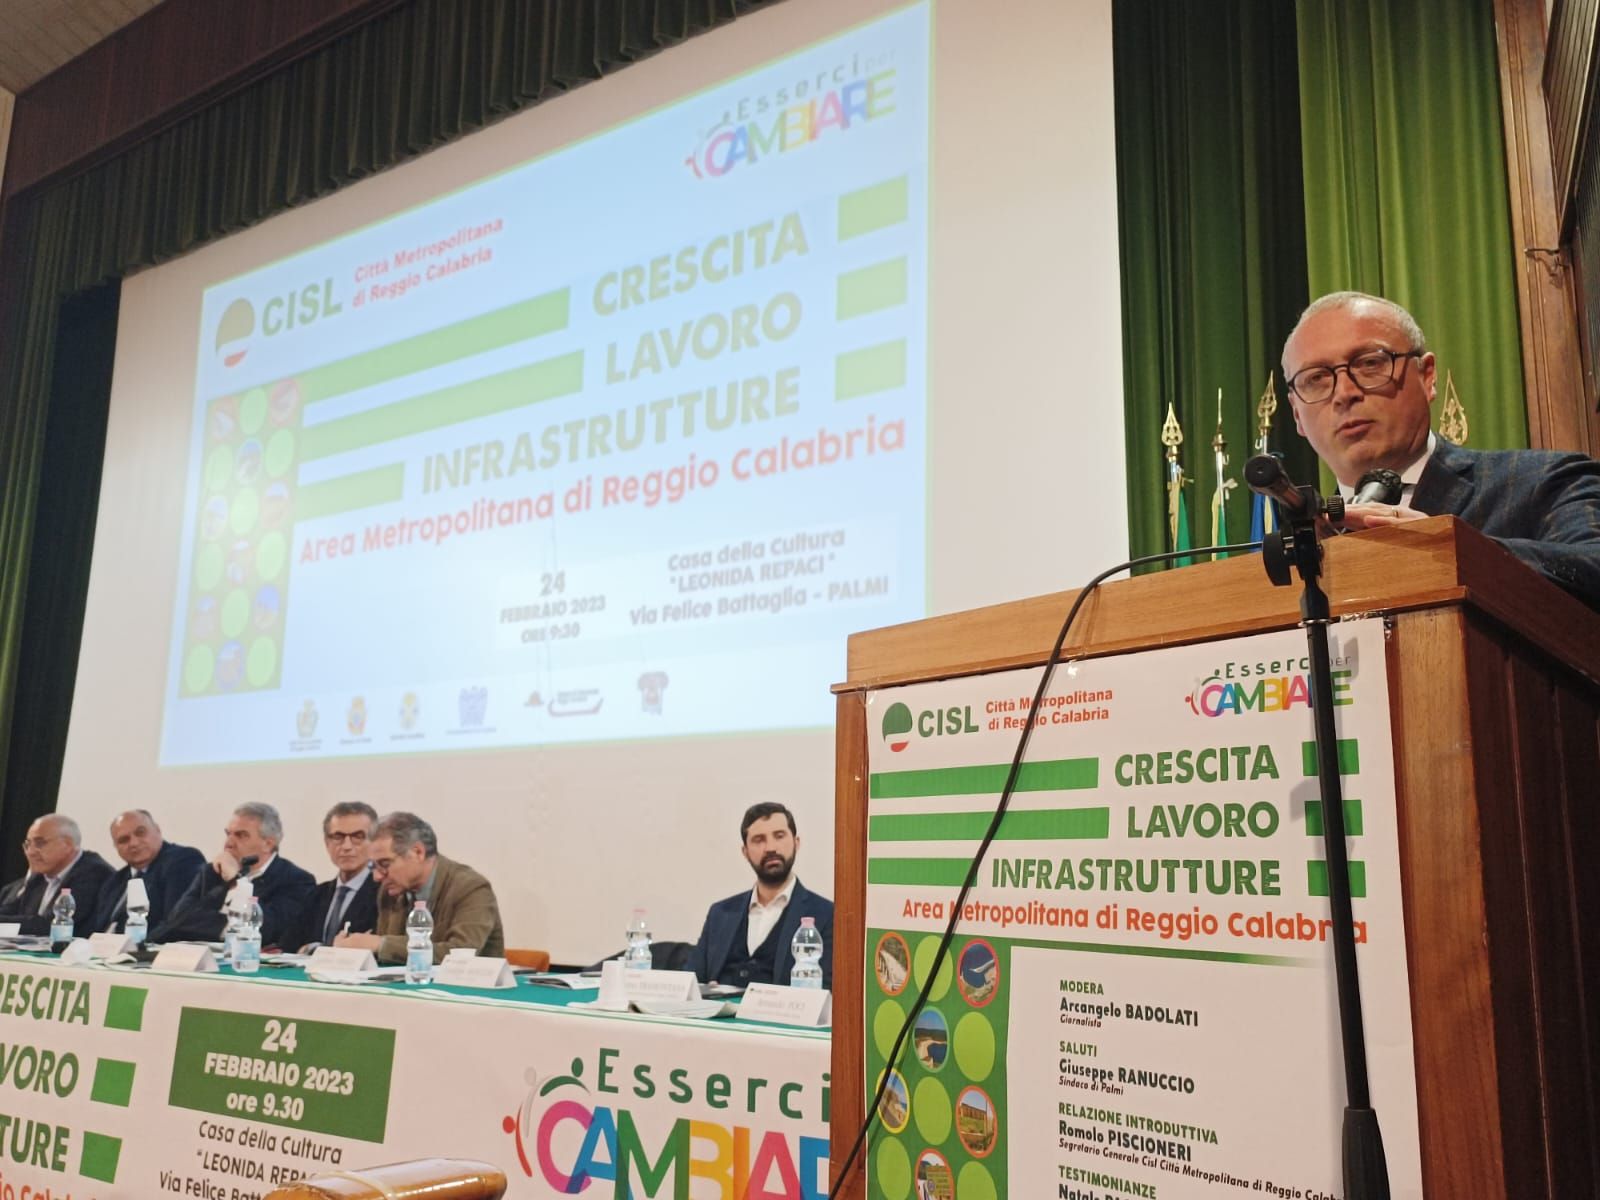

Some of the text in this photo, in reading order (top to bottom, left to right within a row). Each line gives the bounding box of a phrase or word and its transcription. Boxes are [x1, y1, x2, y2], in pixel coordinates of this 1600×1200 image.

[737, 52, 859, 123] Esserci
[704, 68, 896, 177] CAMBIARE
[354, 217, 503, 282] Città Metropolitana
[592, 212, 809, 316] CRESCITA
[352, 246, 492, 308] di Reggio Calabria
[261, 277, 343, 337] CISL
[605, 292, 803, 385] LAVORO
[421, 365, 801, 494] INFRASTRUTTURE
[300, 414, 905, 562] Area Metropolitana di Reggio Calabria
[667, 528, 845, 572] Casa della Cultura
[540, 571, 565, 597] 24
[629, 606, 656, 626] Via
[662, 599, 712, 623] Felice
[717, 586, 807, 616] Battaglia
[827, 576, 889, 602] PALMI
[500, 595, 606, 624] FEBBRAIO 2023
[1226, 657, 1310, 678] Esserc
[985, 689, 1113, 714] Città Mtropolitana
[1200, 669, 1354, 718] CAMBIAE
[917, 704, 979, 738] CISL
[988, 707, 1109, 732] di Regio Calabria
[1114, 744, 1279, 787] CRESCITA
[1127, 801, 1280, 839] LAVORO
[991, 857, 1281, 897] INFRASTRUTTURE
[903, 899, 944, 919] Area
[1096, 905, 1118, 930] di
[1126, 905, 1219, 941] Reggio
[1227, 912, 1367, 944] Calabra
[1059, 979, 1104, 996] MODERA
[1060, 997, 1199, 1027] Arcangelo BADOLATI
[1060, 1014, 1102, 1028] Giornalista
[261, 1020, 297, 1054] 24
[1059, 1041, 1097, 1057] SALUTI
[204, 1052, 355, 1095] FEBBRAIO 2023
[597, 1047, 830, 1123] Esserci
[1059, 1059, 1195, 1094] Giuseppe RANUCCIO
[1059, 1075, 1124, 1096] Sindaco di Palmi
[226, 1092, 305, 1121] ore 9.30
[1059, 1102, 1219, 1145] RELAZIONE INTRODUTTIVA
[199, 1120, 343, 1164] Casa della Cultura
[1059, 1120, 1192, 1162] Romolo PISCIONERI
[160, 1170, 181, 1193] Via
[185, 1178, 226, 1200] Felice
[1058, 1165, 1157, 1200] TESTIMONIANZE
[1059, 1138, 1101, 1156] Segretario
[1103, 1147, 1140, 1165] Generale
[1141, 1154, 1158, 1169] Cisl
[1160, 1158, 1181, 1174] Città
[1182, 1164, 1250, 1188] Metropolitana
[1252, 1178, 1263, 1192] di
[1265, 1181, 1302, 1200] Reggio
